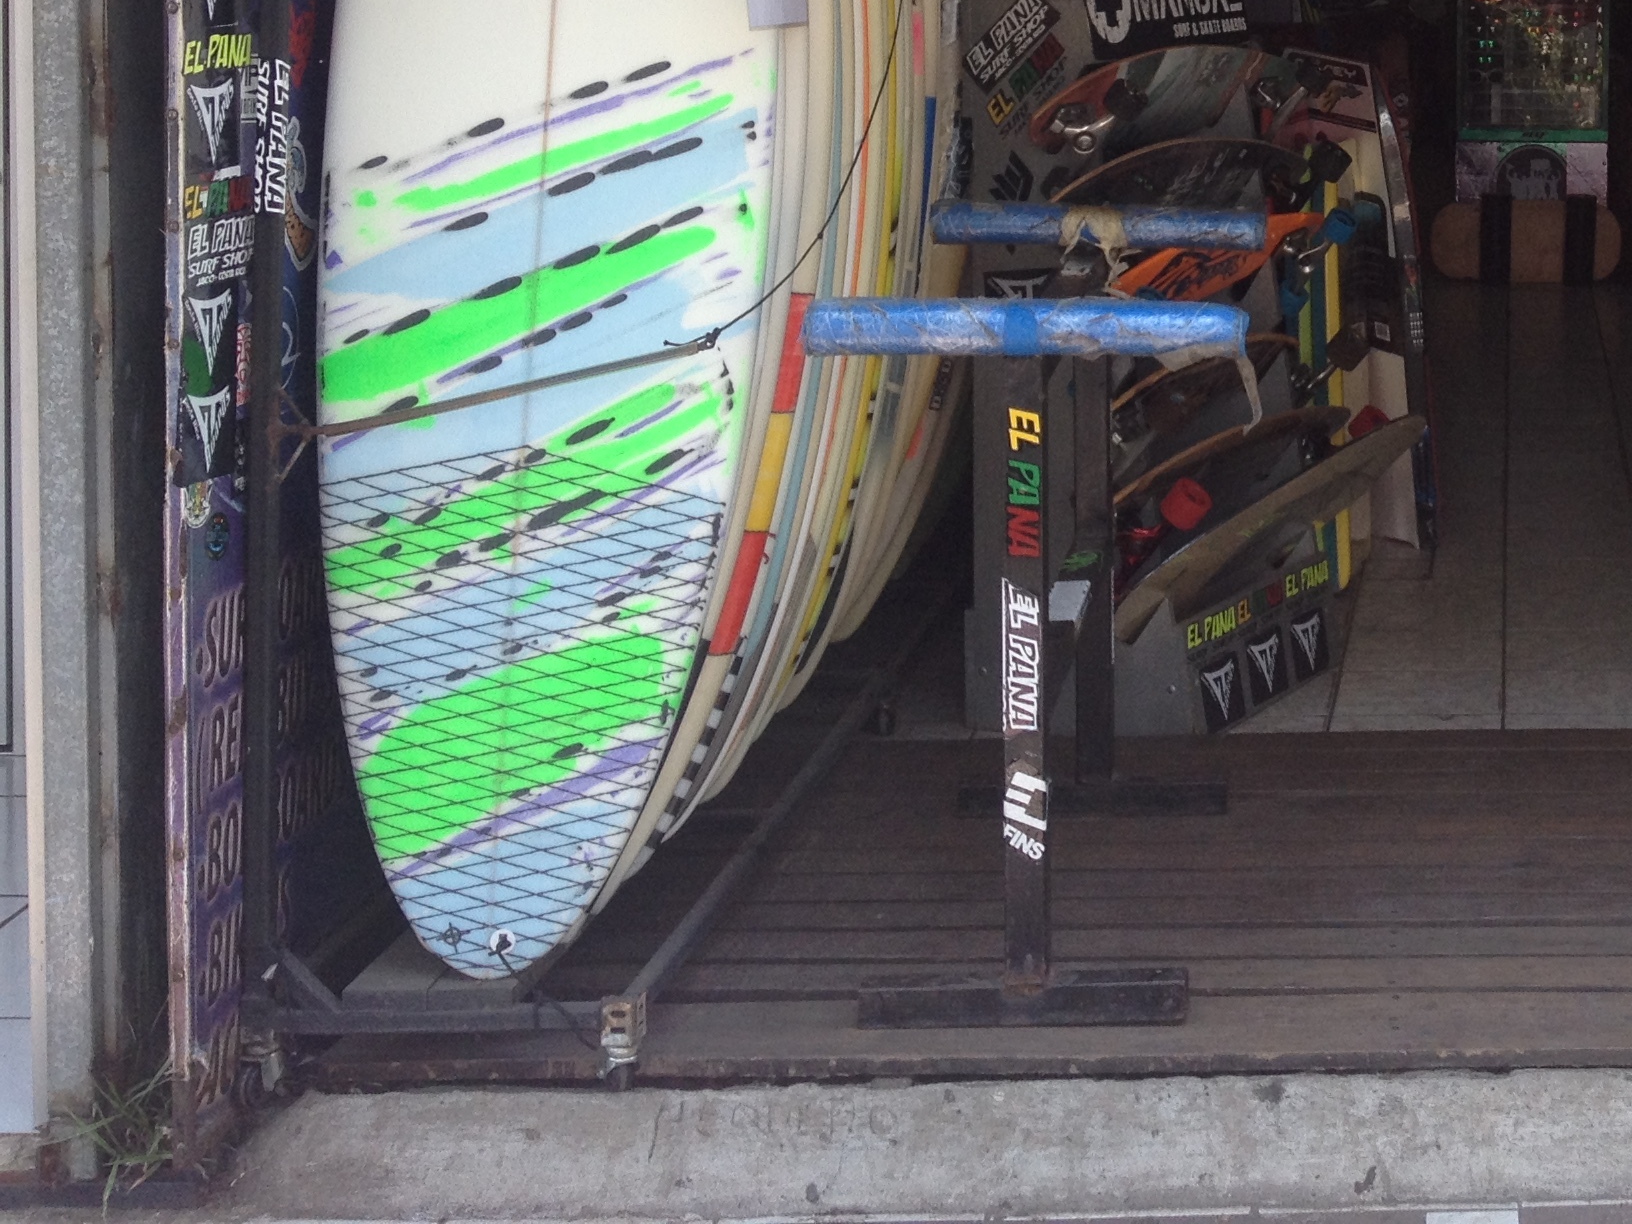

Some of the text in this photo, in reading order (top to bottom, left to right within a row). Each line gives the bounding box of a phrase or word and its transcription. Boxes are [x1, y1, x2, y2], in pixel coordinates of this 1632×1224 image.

[184, 32, 252, 75] EL PANA
[966, 40, 993, 76] EL
[980, 4, 1048, 84] SURF SHOP
[985, 88, 1016, 126] EL
[265, 58, 291, 214] EL PANA
[185, 186, 203, 220] EL
[188, 214, 255, 260] EL PANA
[188, 256, 221, 278] SURF
[1006, 407, 1042, 558] EL PANA
[1285, 560, 1330, 598] EL PANA
[1187, 606, 1237, 649] EL PANA
[1237, 598, 1252, 624] EL
[1005, 582, 1040, 733] EL PANA
[1003, 823, 1046, 860] FINS
